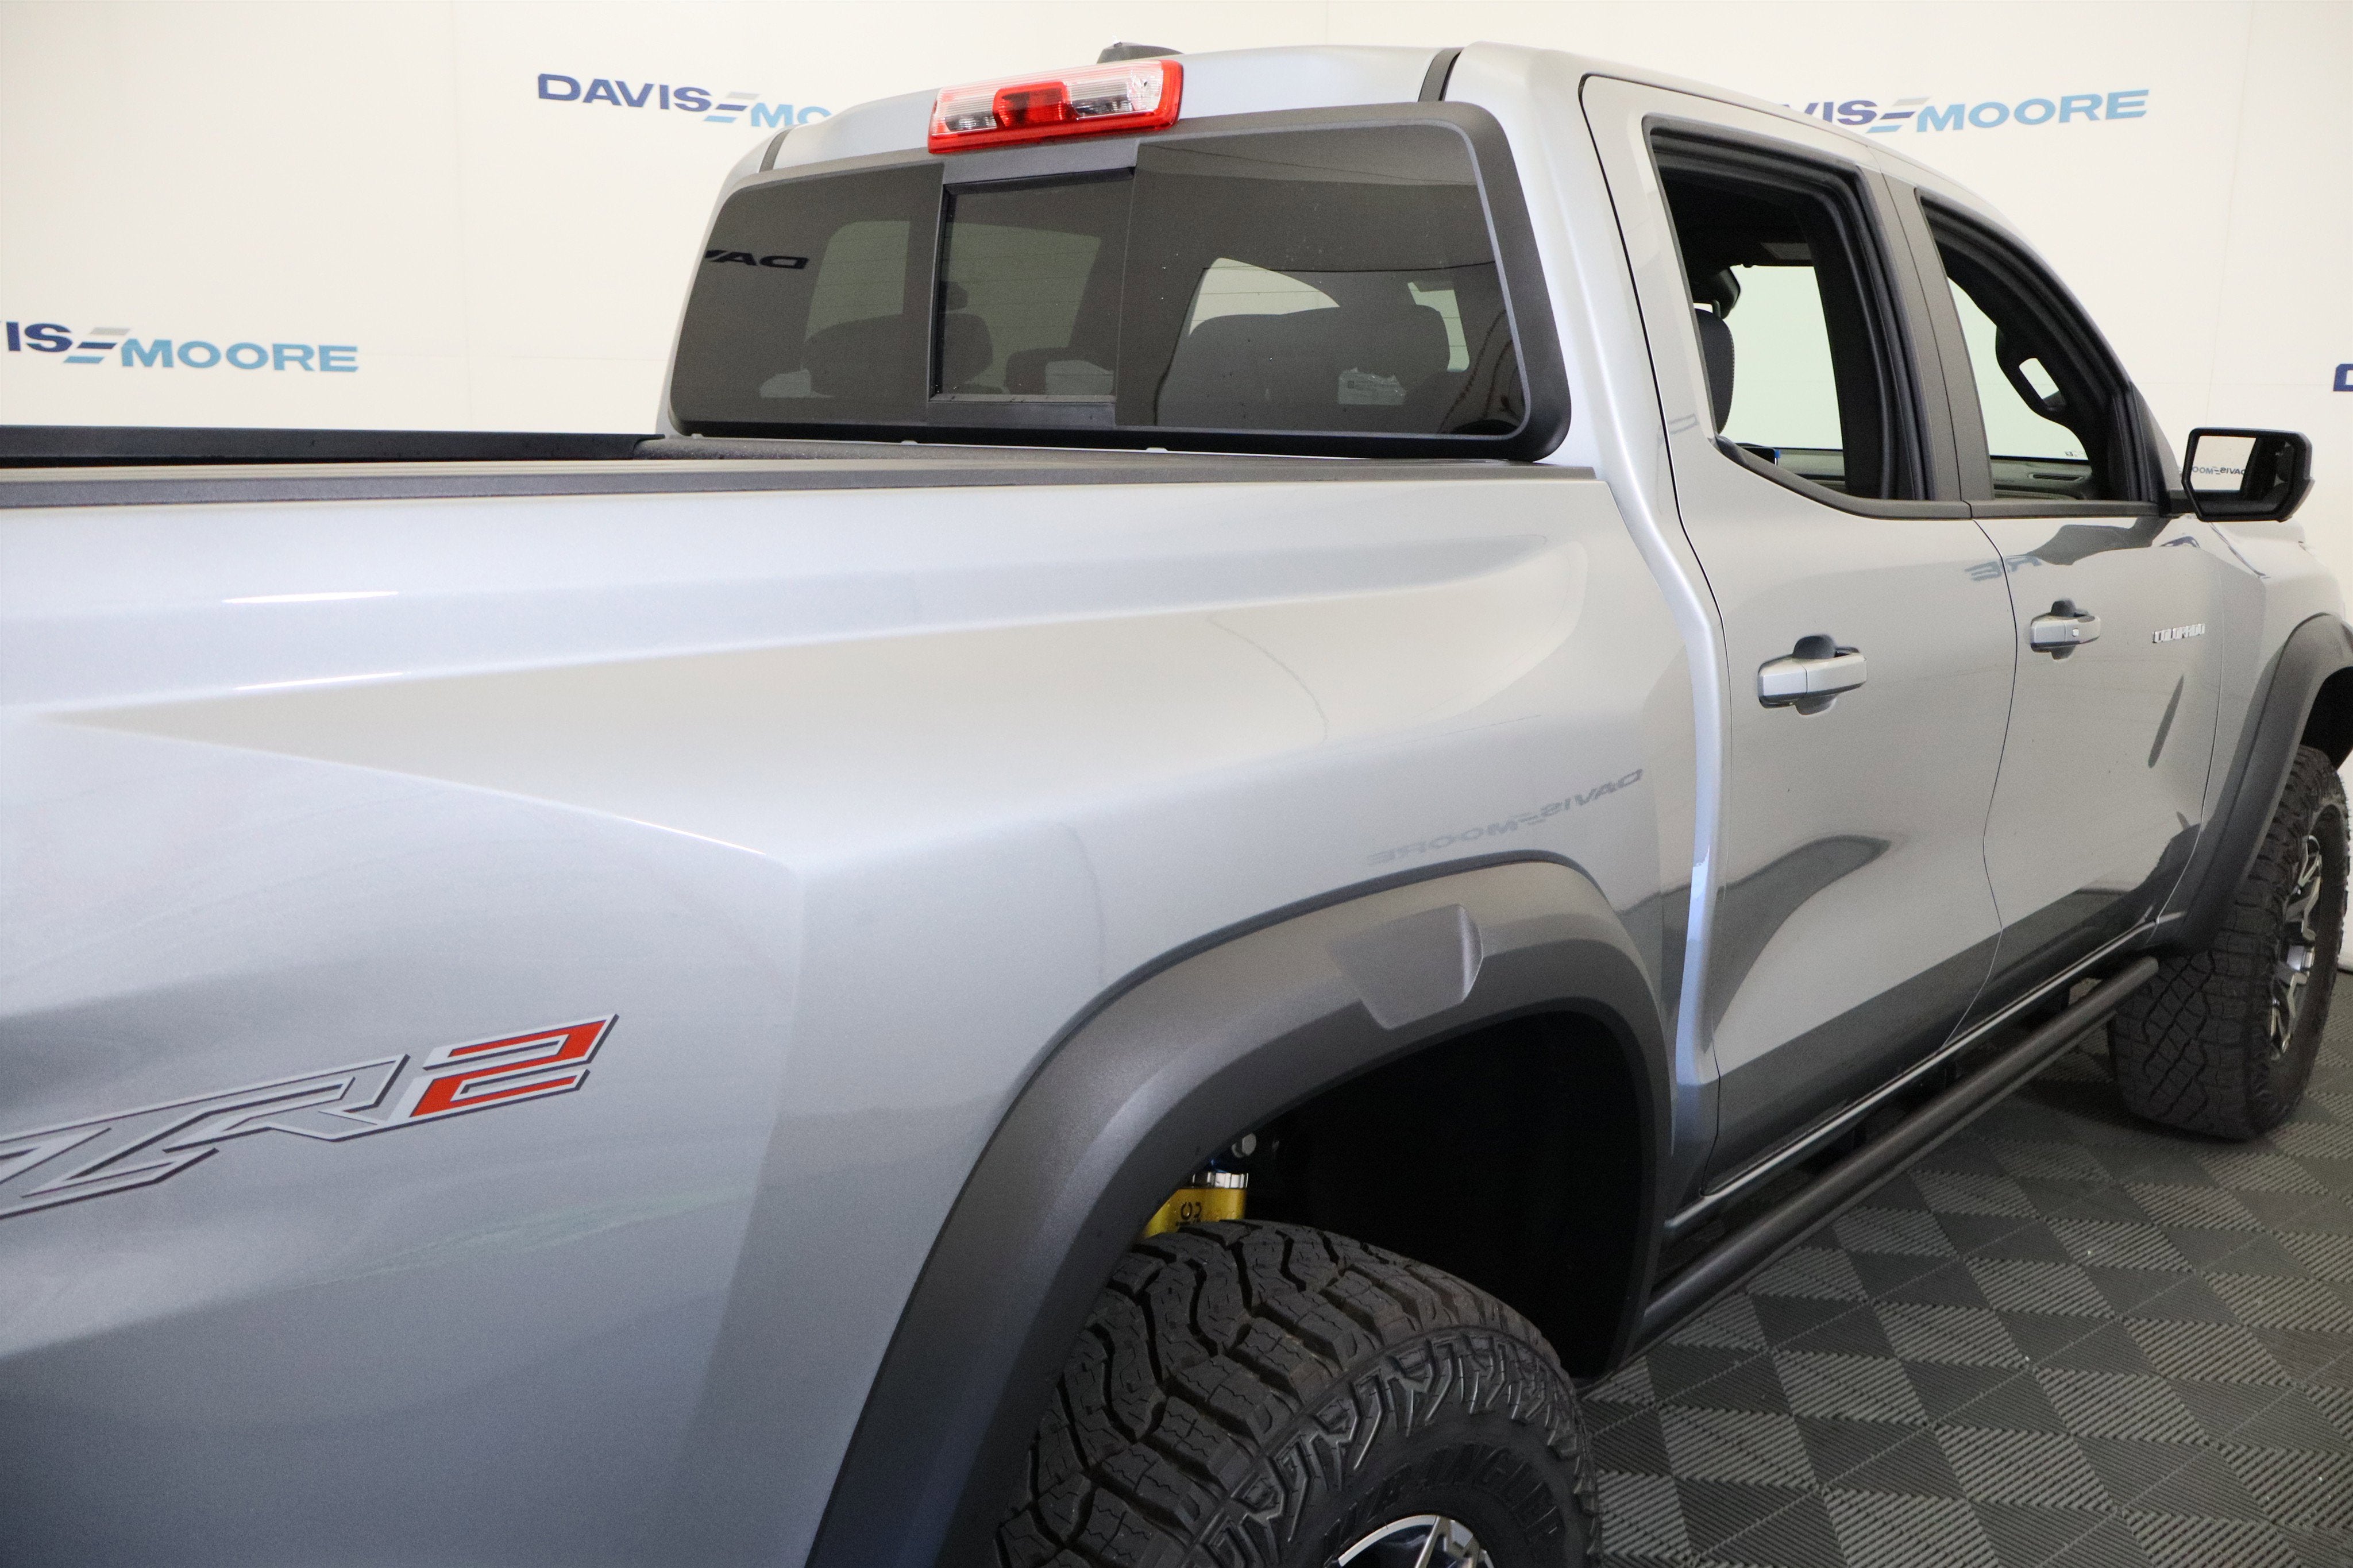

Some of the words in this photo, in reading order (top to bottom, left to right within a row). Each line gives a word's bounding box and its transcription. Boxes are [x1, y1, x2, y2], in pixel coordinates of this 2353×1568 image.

[538, 73, 712, 113] DAVIS
[1916, 89, 2149, 133] MOORE
[121, 338, 358, 372] MOORE
